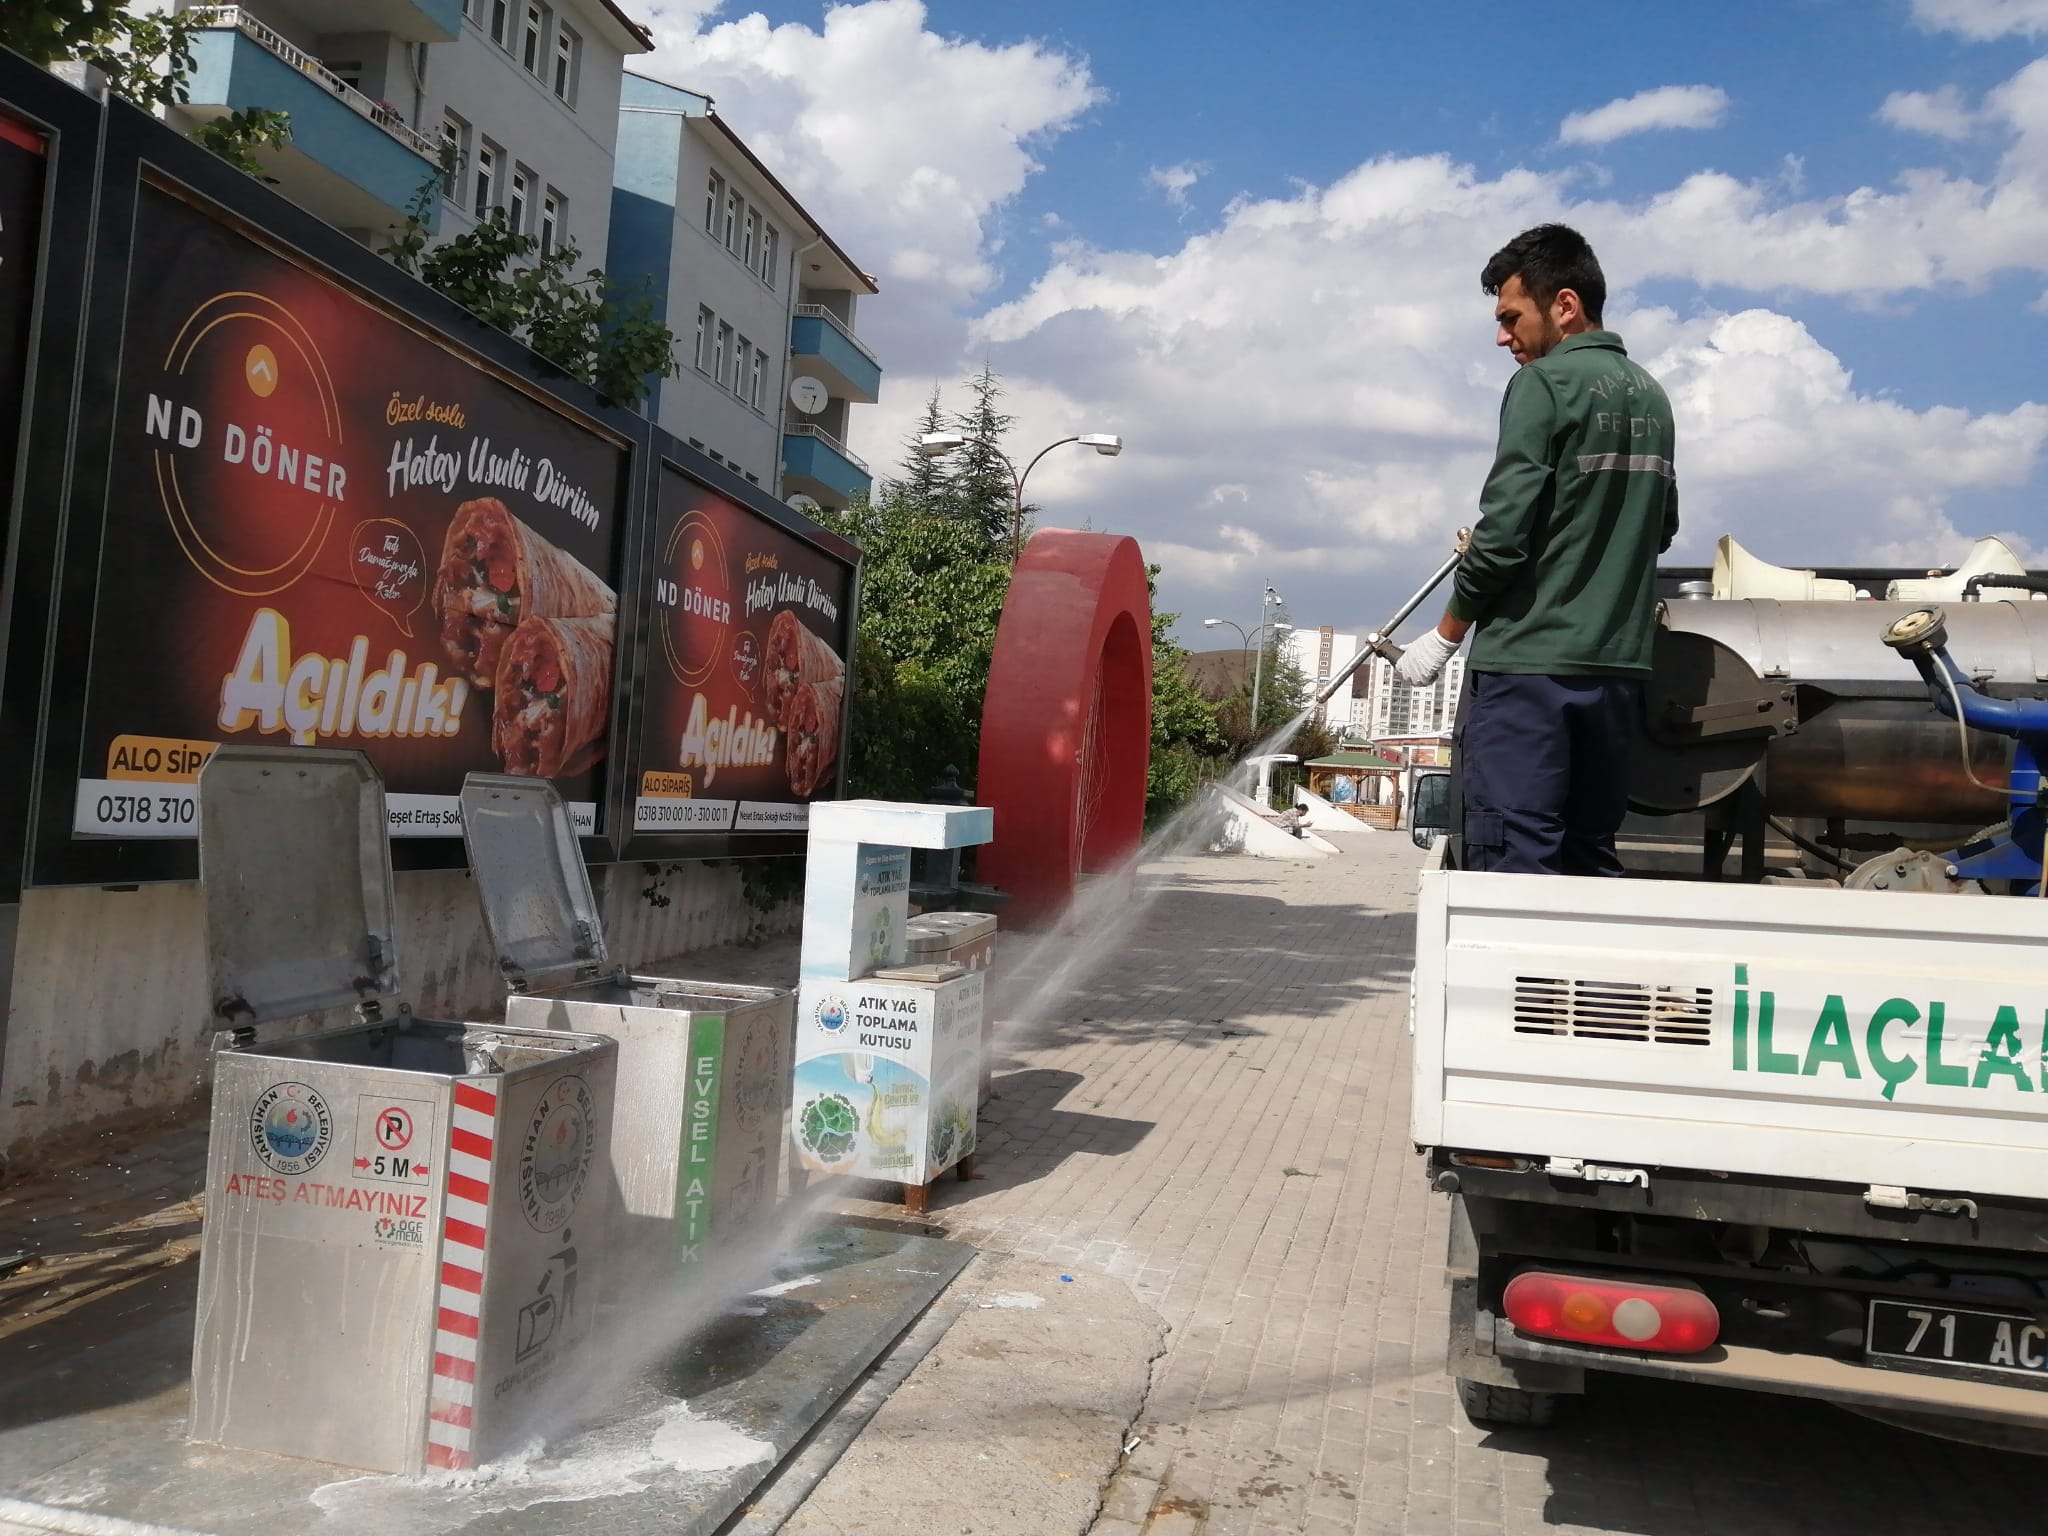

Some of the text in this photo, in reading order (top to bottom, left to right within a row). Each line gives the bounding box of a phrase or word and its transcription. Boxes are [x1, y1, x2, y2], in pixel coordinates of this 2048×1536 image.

[386, 392, 466, 429] Özel soslu
[145, 393, 346, 501] ND DÖNER
[387, 434, 599, 532] Hatay Usulü Dürüm
[657, 577, 730, 625] ND DÖNER
[745, 572, 837, 623] Hatay Usulü Dürüm
[220, 607, 468, 745] Açıldık!
[680, 691, 777, 789] Açıldık!
[112, 747, 161, 772] ALO
[643, 775, 690, 797] ALO SİPARİŞ
[97, 796, 195, 823] 0318 310
[415, 810, 440, 828] Ertaş
[637, 805, 657, 822] 0318
[658, 806, 671, 822] 310
[672, 806, 683, 822] 00
[684, 806, 693, 822] 10
[698, 807, 711, 822] 310
[711, 807, 720, 822] 00
[856, 1014, 918, 1033] TOPLAMA
[859, 996, 917, 1014] ATIK YAĞ
[859, 1033, 912, 1050] KUTUSU
[1733, 962, 2048, 1102] İLAÇLA
[252, 1090, 330, 1168] YAHŞİHAN BELEDİYESİ
[385, 1116, 402, 1140] P
[276, 1158, 300, 1172] 1956
[374, 1156, 409, 1178] 5 M
[520, 1099, 549, 1224] YAHŞİHAN
[681, 1056, 714, 1264] EVSEL ATIK
[226, 1173, 427, 1219] ATEŞ ATMAYINIZ
[396, 1230, 424, 1244] METAL
[1905, 1310, 2045, 1368] 71 AC
